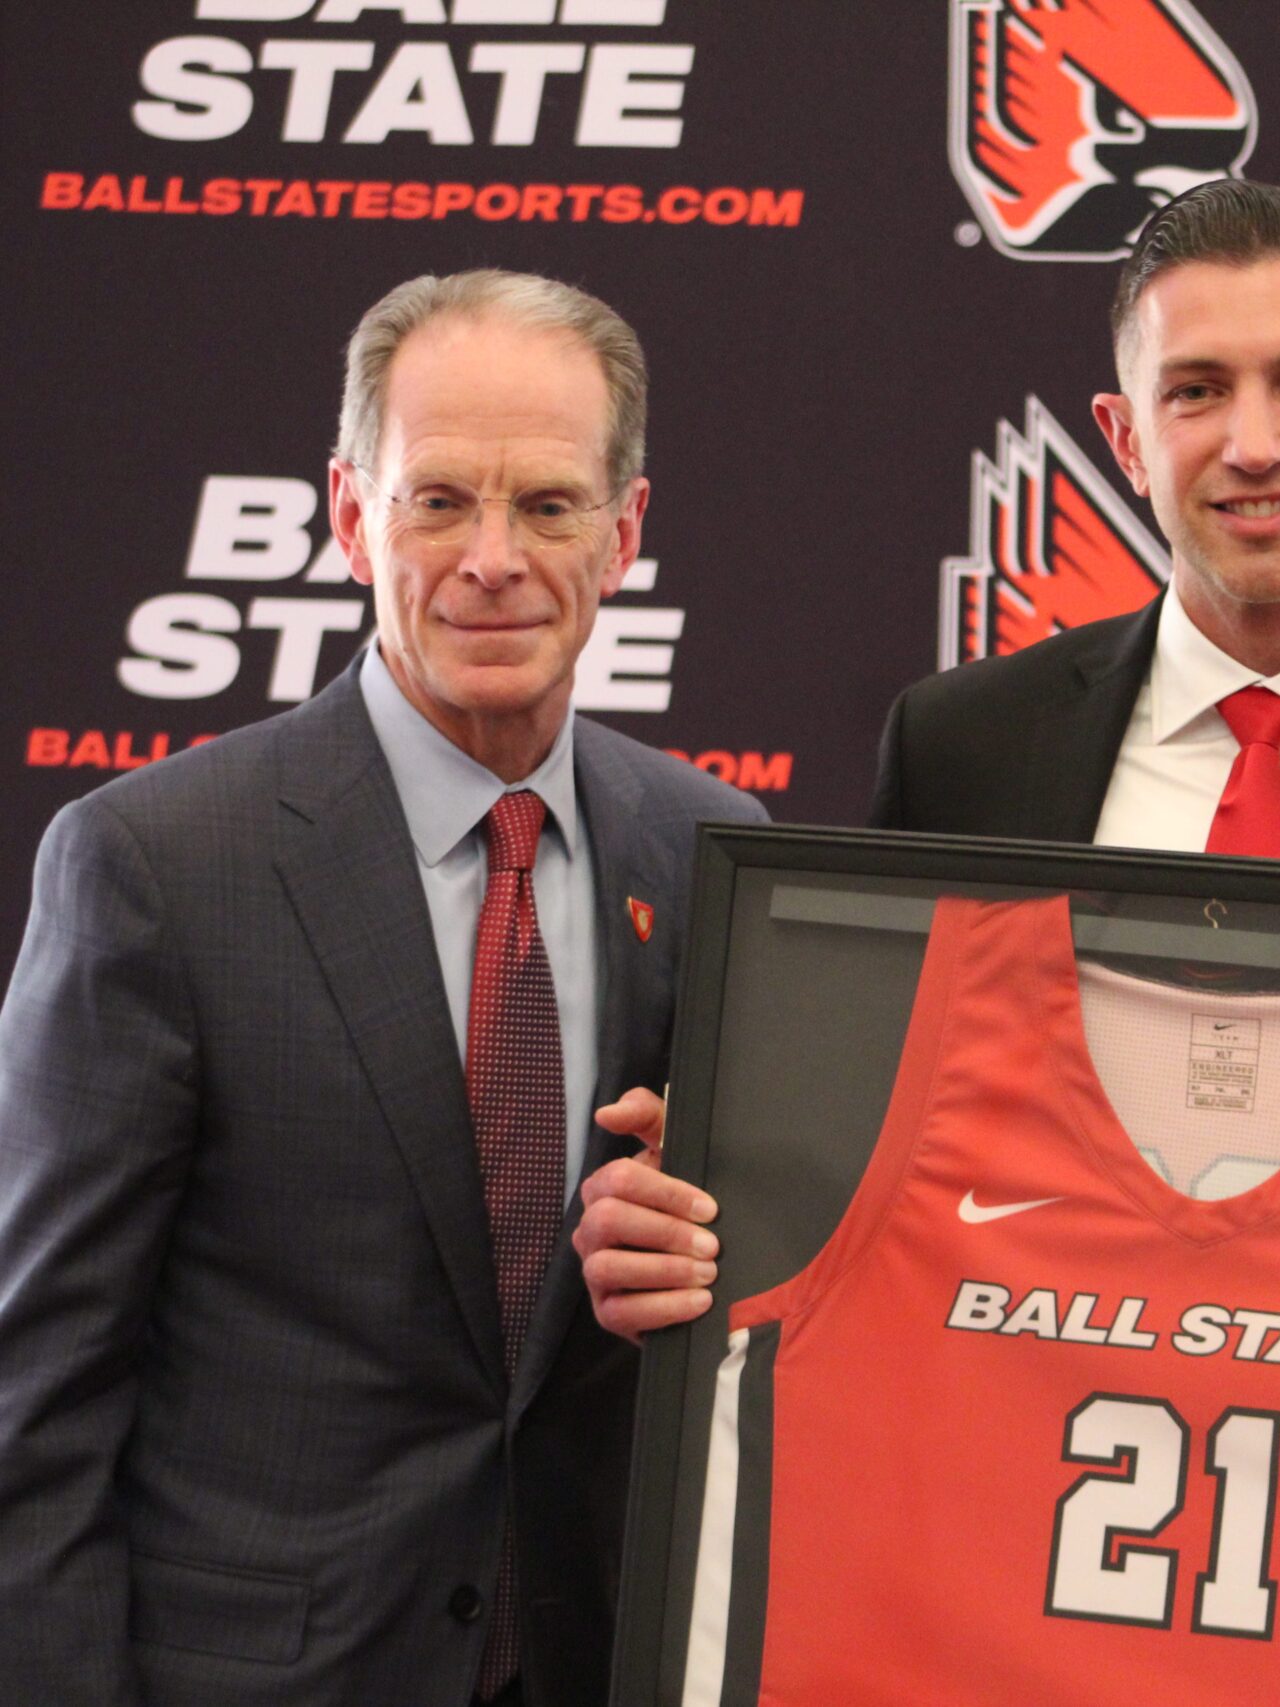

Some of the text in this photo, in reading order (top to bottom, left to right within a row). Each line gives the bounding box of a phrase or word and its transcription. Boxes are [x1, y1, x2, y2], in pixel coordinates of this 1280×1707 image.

[134, 36, 695, 148] STATE
[41, 173, 803, 227] BALLSTATESPORTS.COM
[117, 592, 685, 713] STE
[945, 1279, 1159, 1350] BALL
